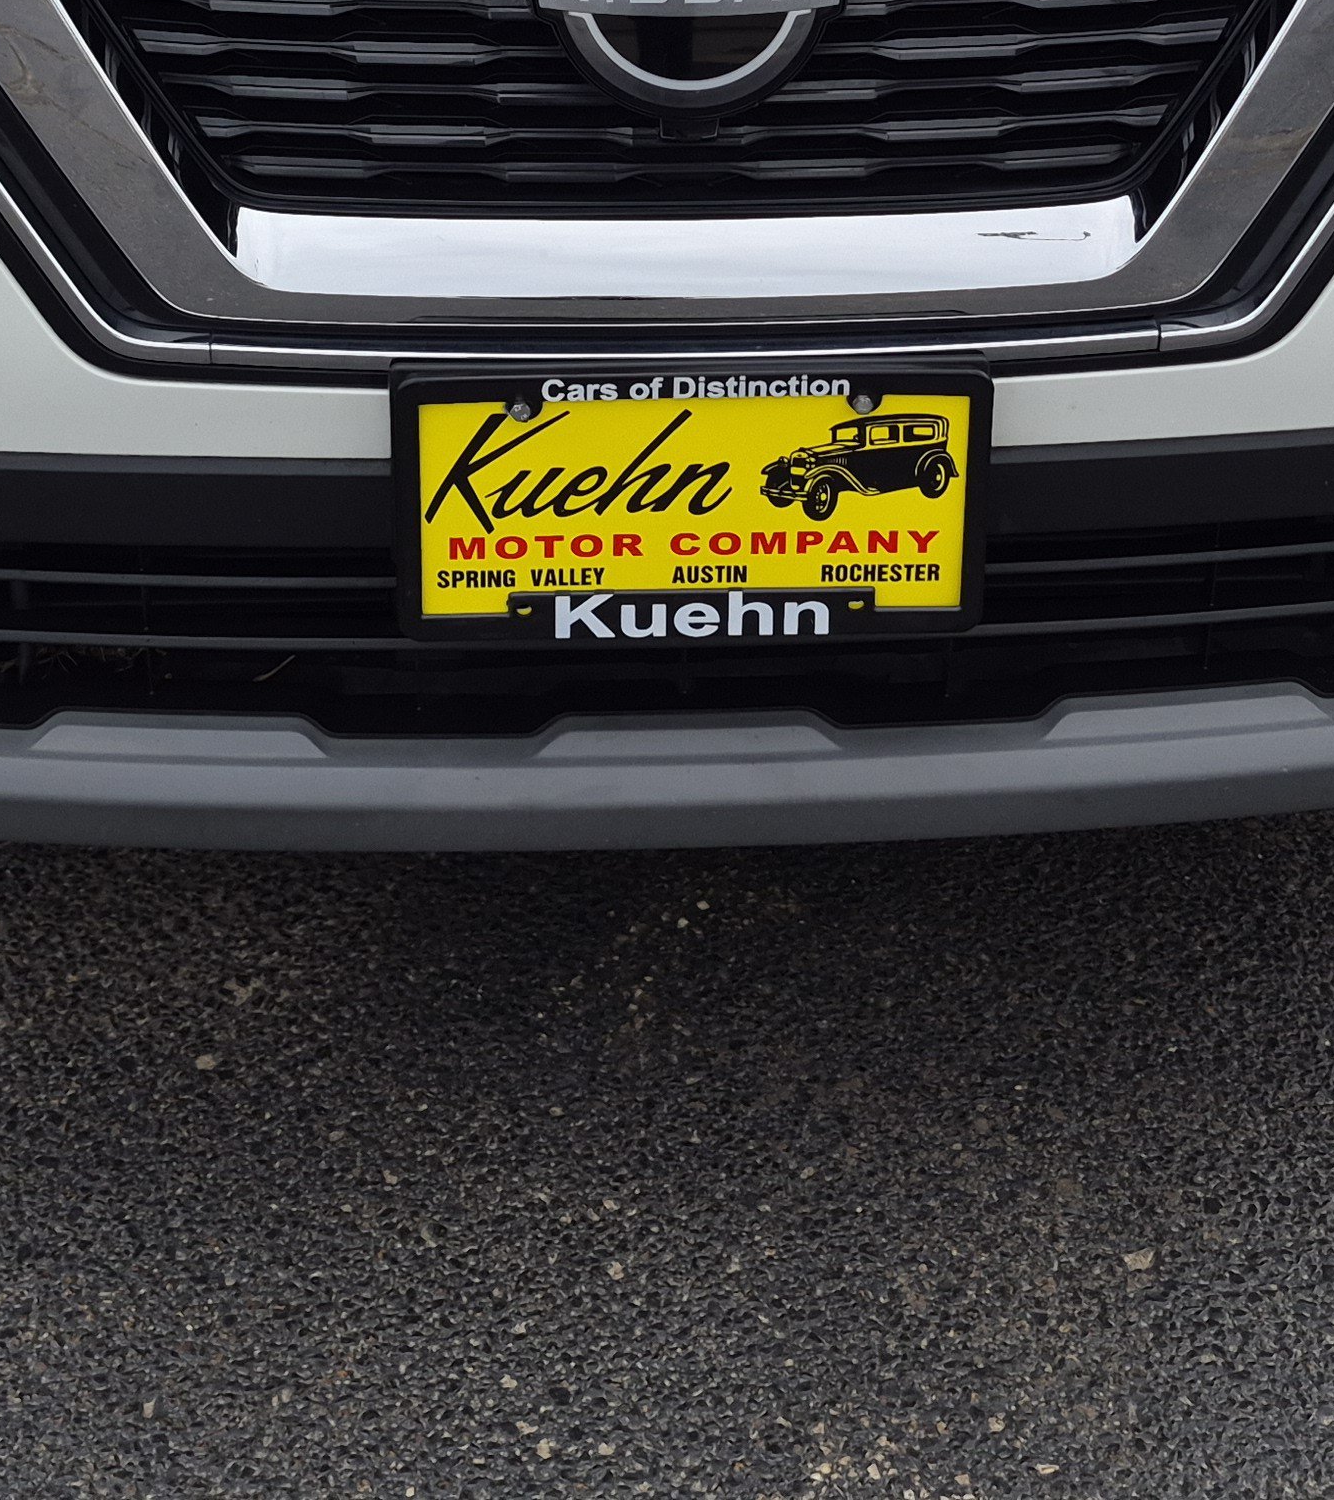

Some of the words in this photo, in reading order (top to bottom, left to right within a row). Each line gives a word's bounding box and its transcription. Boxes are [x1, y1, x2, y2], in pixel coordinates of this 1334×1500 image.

[541, 378, 618, 403] Cars
[629, 377, 664, 401] of
[673, 375, 850, 400] Distinction
[424, 408, 733, 534] Kuehn
[448, 534, 644, 560] MOTOR
[669, 530, 941, 556] COMPANY
[436, 569, 516, 589] SPRING
[530, 567, 605, 587] VALLEY
[672, 565, 748, 584] AUSTIN
[820, 563, 941, 583] ROCHESTER
[554, 591, 831, 640] Kuehn
